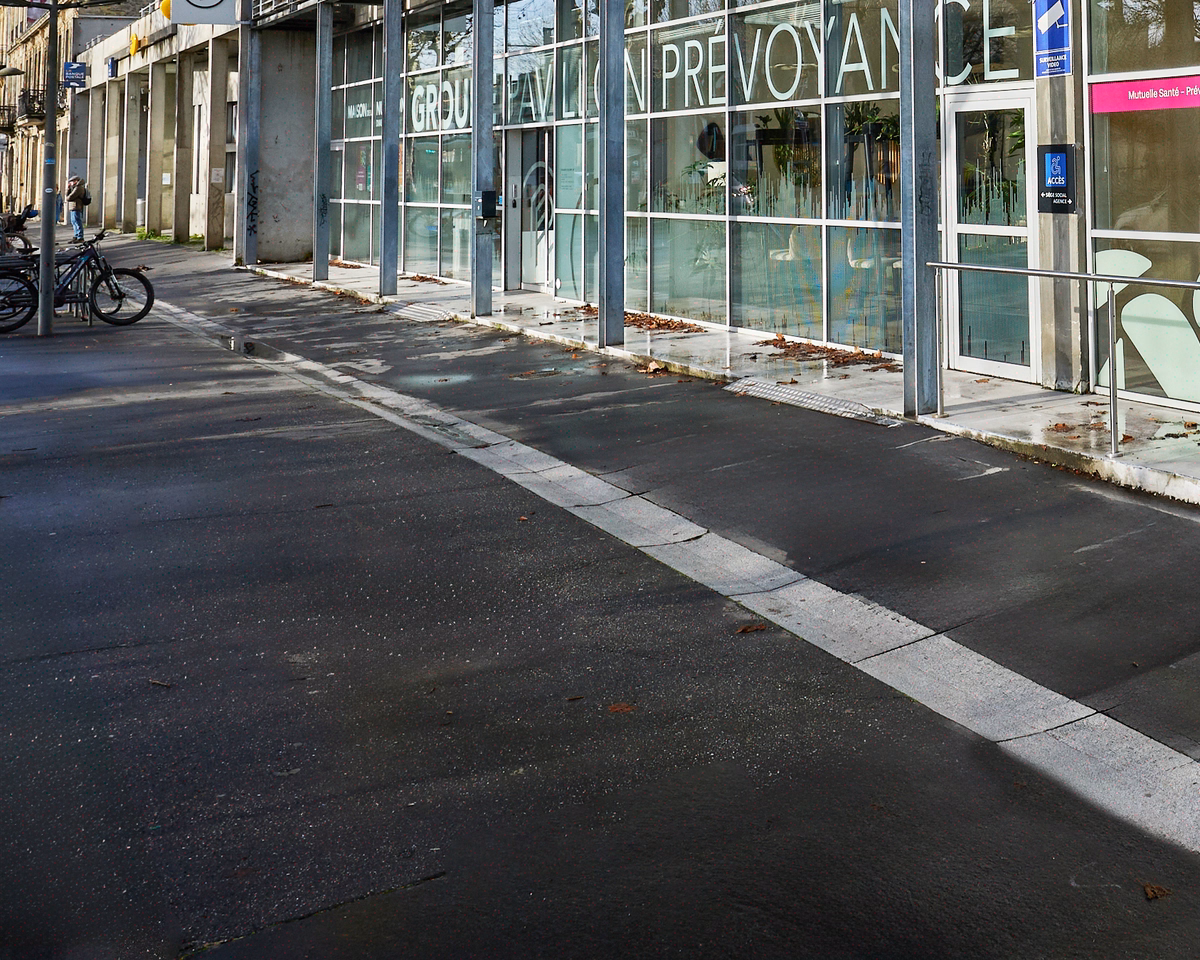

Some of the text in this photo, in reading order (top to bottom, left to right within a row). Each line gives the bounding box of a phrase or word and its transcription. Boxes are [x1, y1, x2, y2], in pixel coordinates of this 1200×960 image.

[1039, 54, 1066, 64] SURVEILLANCE
[411, 74, 498, 132] GROU
[507, 48, 645, 124] PAVLLN
[1128, 88, 1158, 100] Mutuelle
[1158, 86, 1179, 98] Santé
[1047, 175, 1065, 185] ACCÈS
